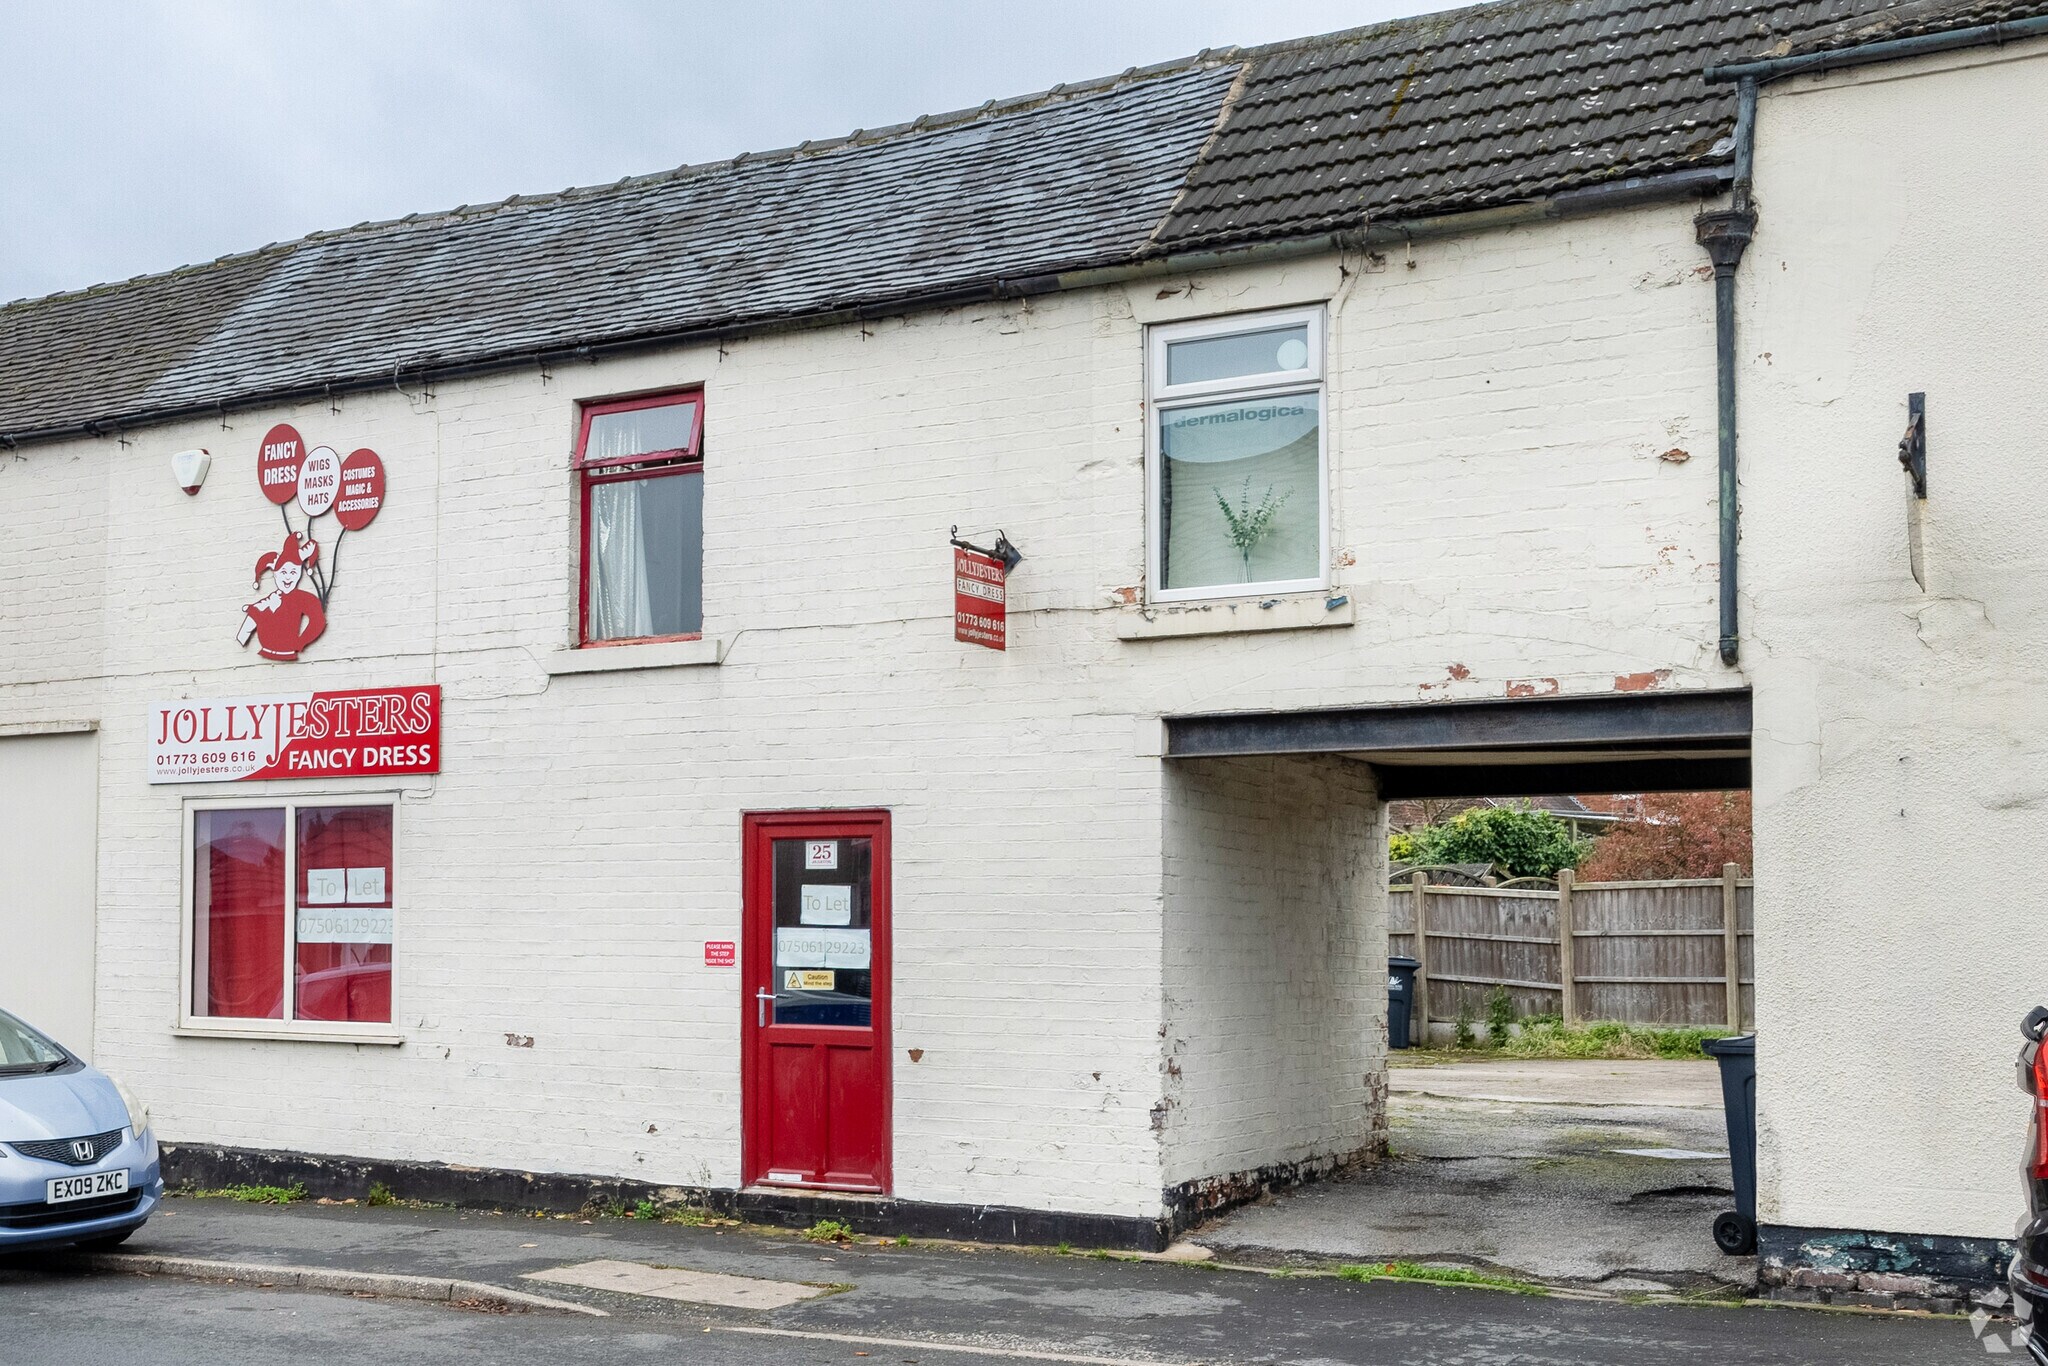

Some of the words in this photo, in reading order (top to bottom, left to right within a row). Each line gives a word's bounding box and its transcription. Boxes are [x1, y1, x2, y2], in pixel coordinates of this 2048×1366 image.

[1174, 405, 1304, 428] dermalogica
[264, 440, 298, 462] FANCY
[308, 458, 331, 472] WIGS
[264, 465, 297, 486] DRESS
[343, 466, 376, 481] COSTUMES
[304, 475, 334, 490] MASKS
[345, 483, 366, 497] MAGIC
[366, 482, 372, 494] &
[307, 492, 329, 506] HATS
[338, 496, 379, 512] ACCESSORIES
[956, 557, 1004, 583] JOLLYJESTERS
[957, 579, 980, 595] FANCY
[982, 585, 1003, 600] DRESS
[957, 612, 978, 627] 01773
[979, 616, 992, 630] 609
[992, 619, 1005, 632] 616
[156, 753, 197, 766] 01773
[201, 752, 226, 764] 609
[231, 750, 256, 762] 616
[288, 748, 357, 770] FANCY
[363, 744, 431, 767] DRESS
[156, 764, 256, 776] www.jollyjesters.co.uk
[812, 844, 832, 860] 25
[317, 877, 337, 897] To
[354, 876, 380, 896] Let
[803, 895, 821, 911] To
[826, 896, 849, 911] Let
[778, 940, 865, 955] 07506129223
[807, 973, 828, 981] Caution
[54, 1177, 93, 1199] EX09
[96, 1172, 123, 1193] ZKC
